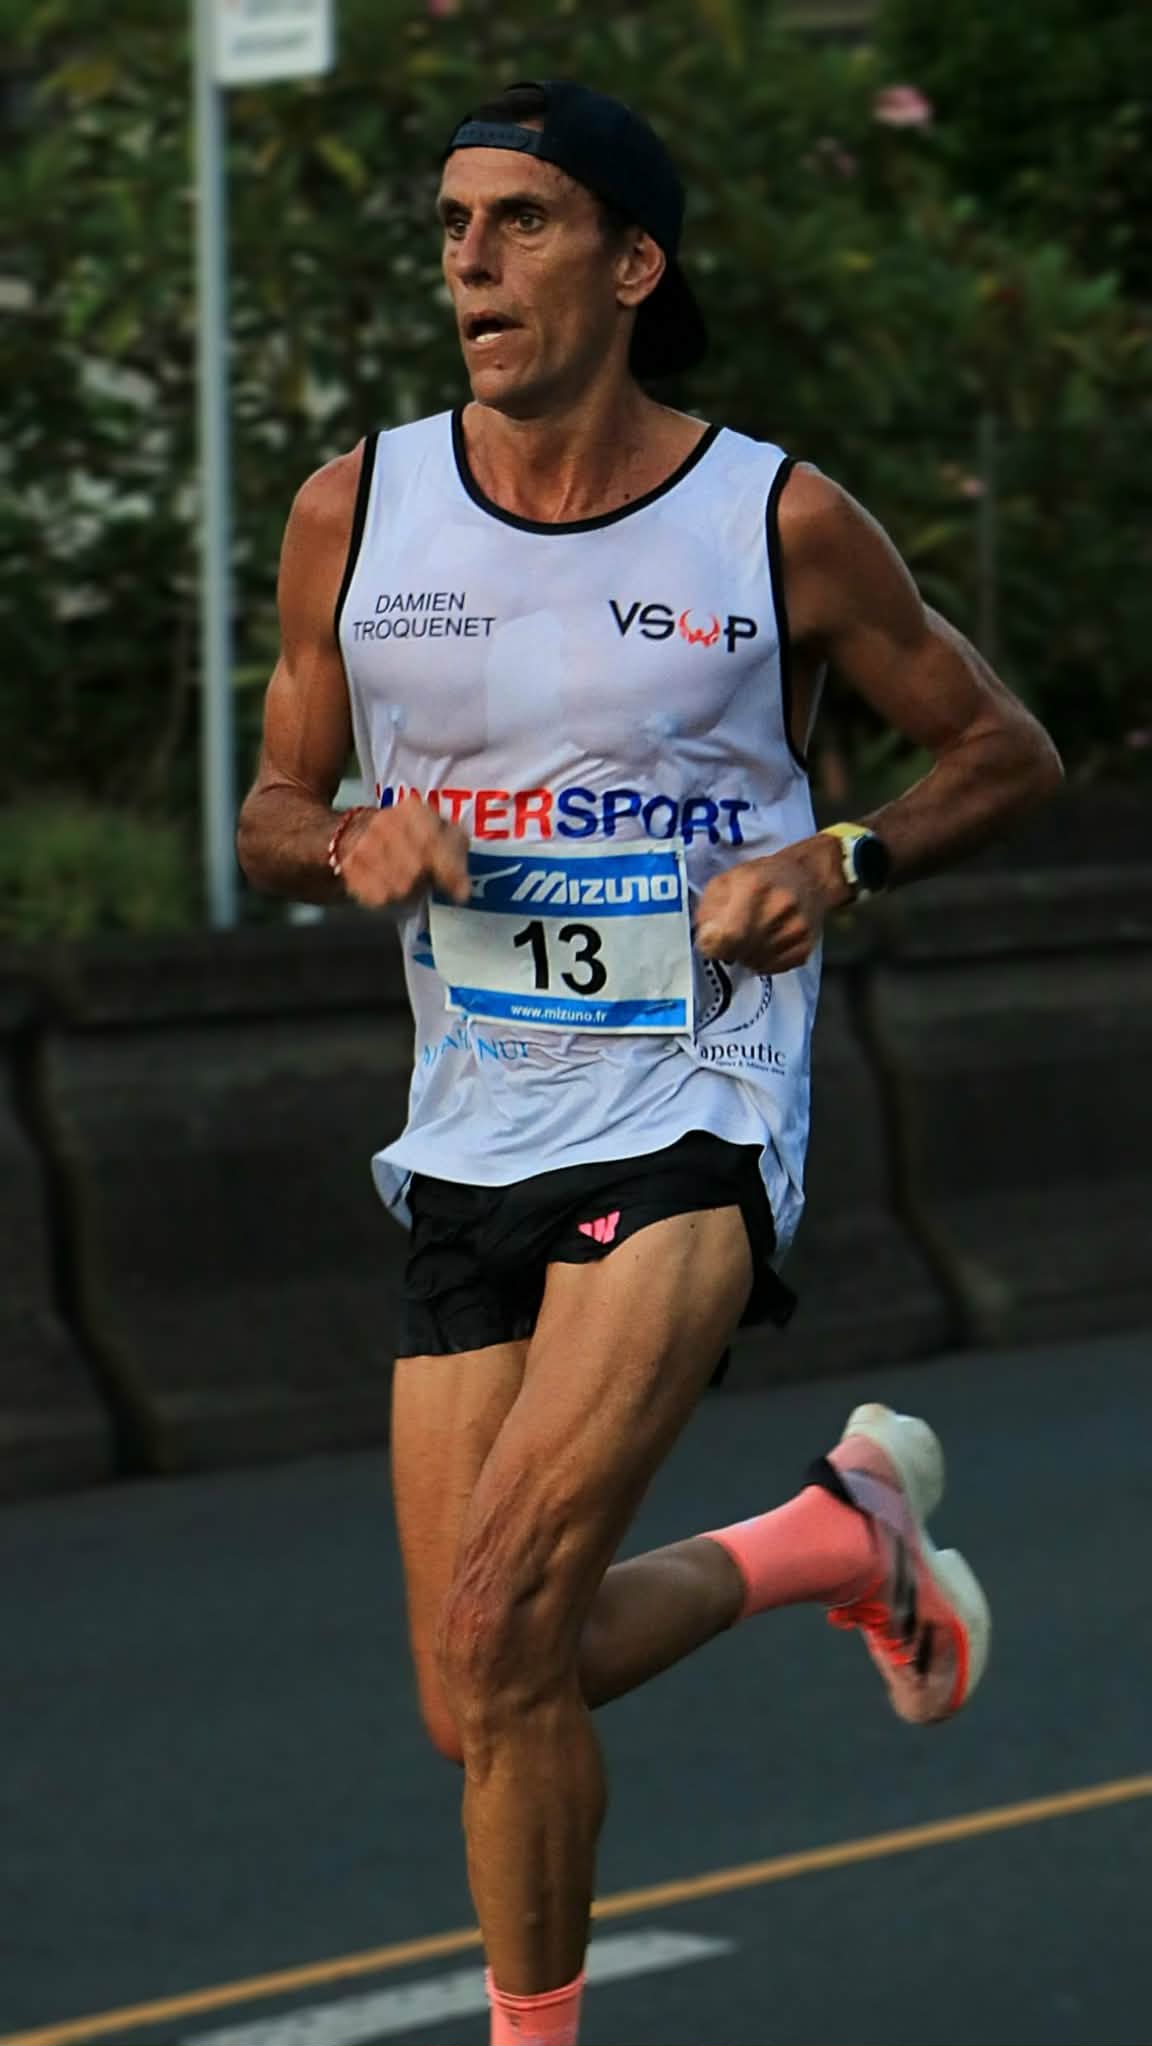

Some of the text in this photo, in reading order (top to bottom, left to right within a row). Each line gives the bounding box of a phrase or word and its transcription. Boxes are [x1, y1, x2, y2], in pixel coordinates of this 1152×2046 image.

[375, 591, 466, 615] DAMIEN
[352, 616, 497, 641] TROQUENET
[513, 920, 607, 995] 13
[510, 1004, 608, 1023] www.mizuno.fr
